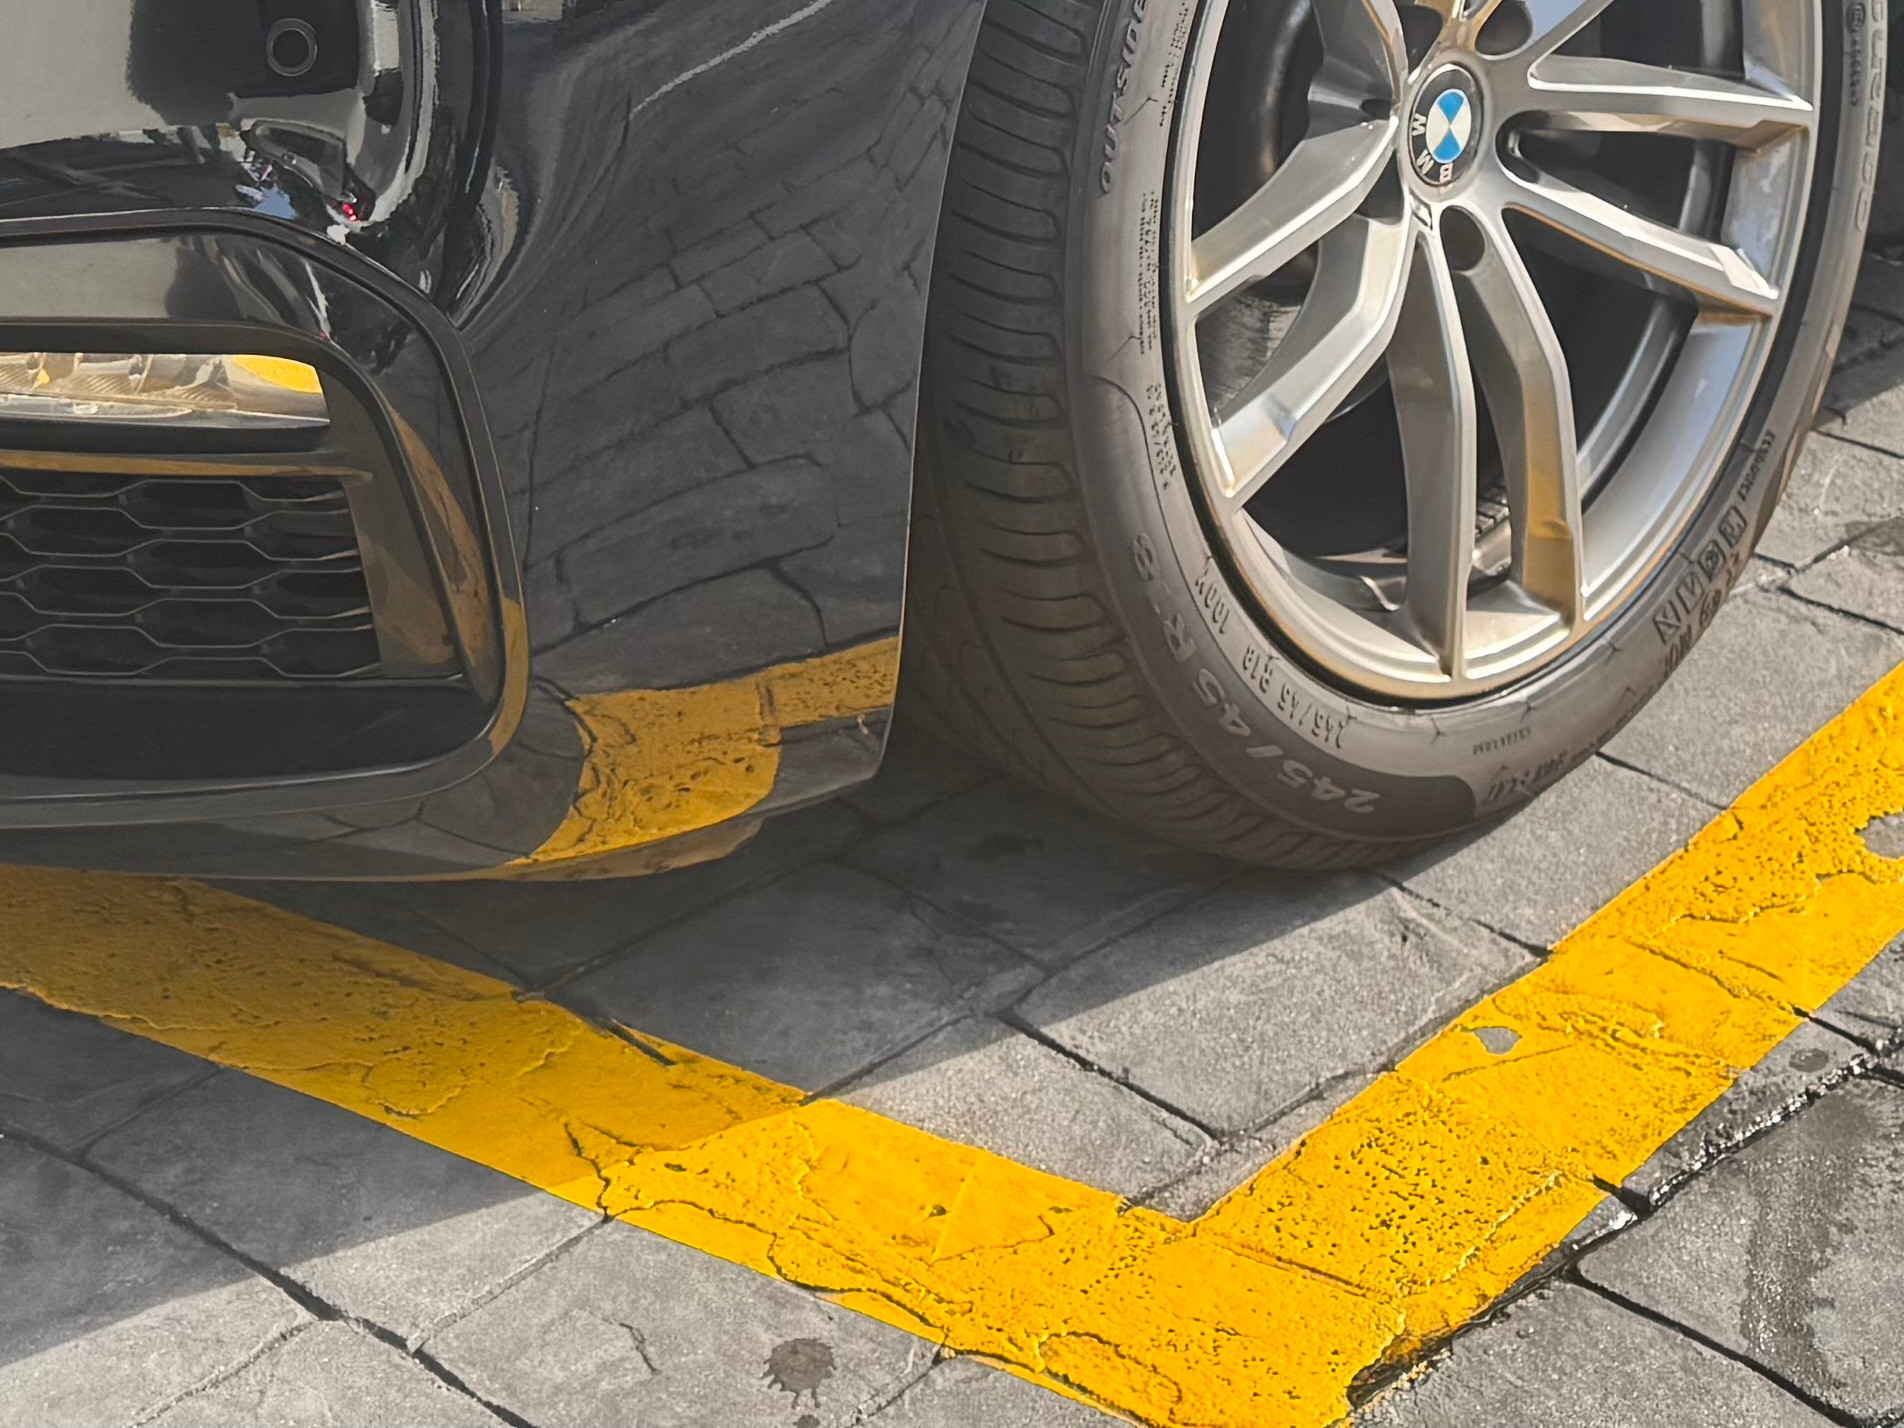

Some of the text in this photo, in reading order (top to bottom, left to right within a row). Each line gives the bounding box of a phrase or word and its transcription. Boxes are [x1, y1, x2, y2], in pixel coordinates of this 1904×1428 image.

[1411, 112, 1454, 184] BMW
[1241, 644, 1274, 695] R18
[1193, 668, 1381, 814] 245/45
[1276, 682, 1345, 751] 245/45
